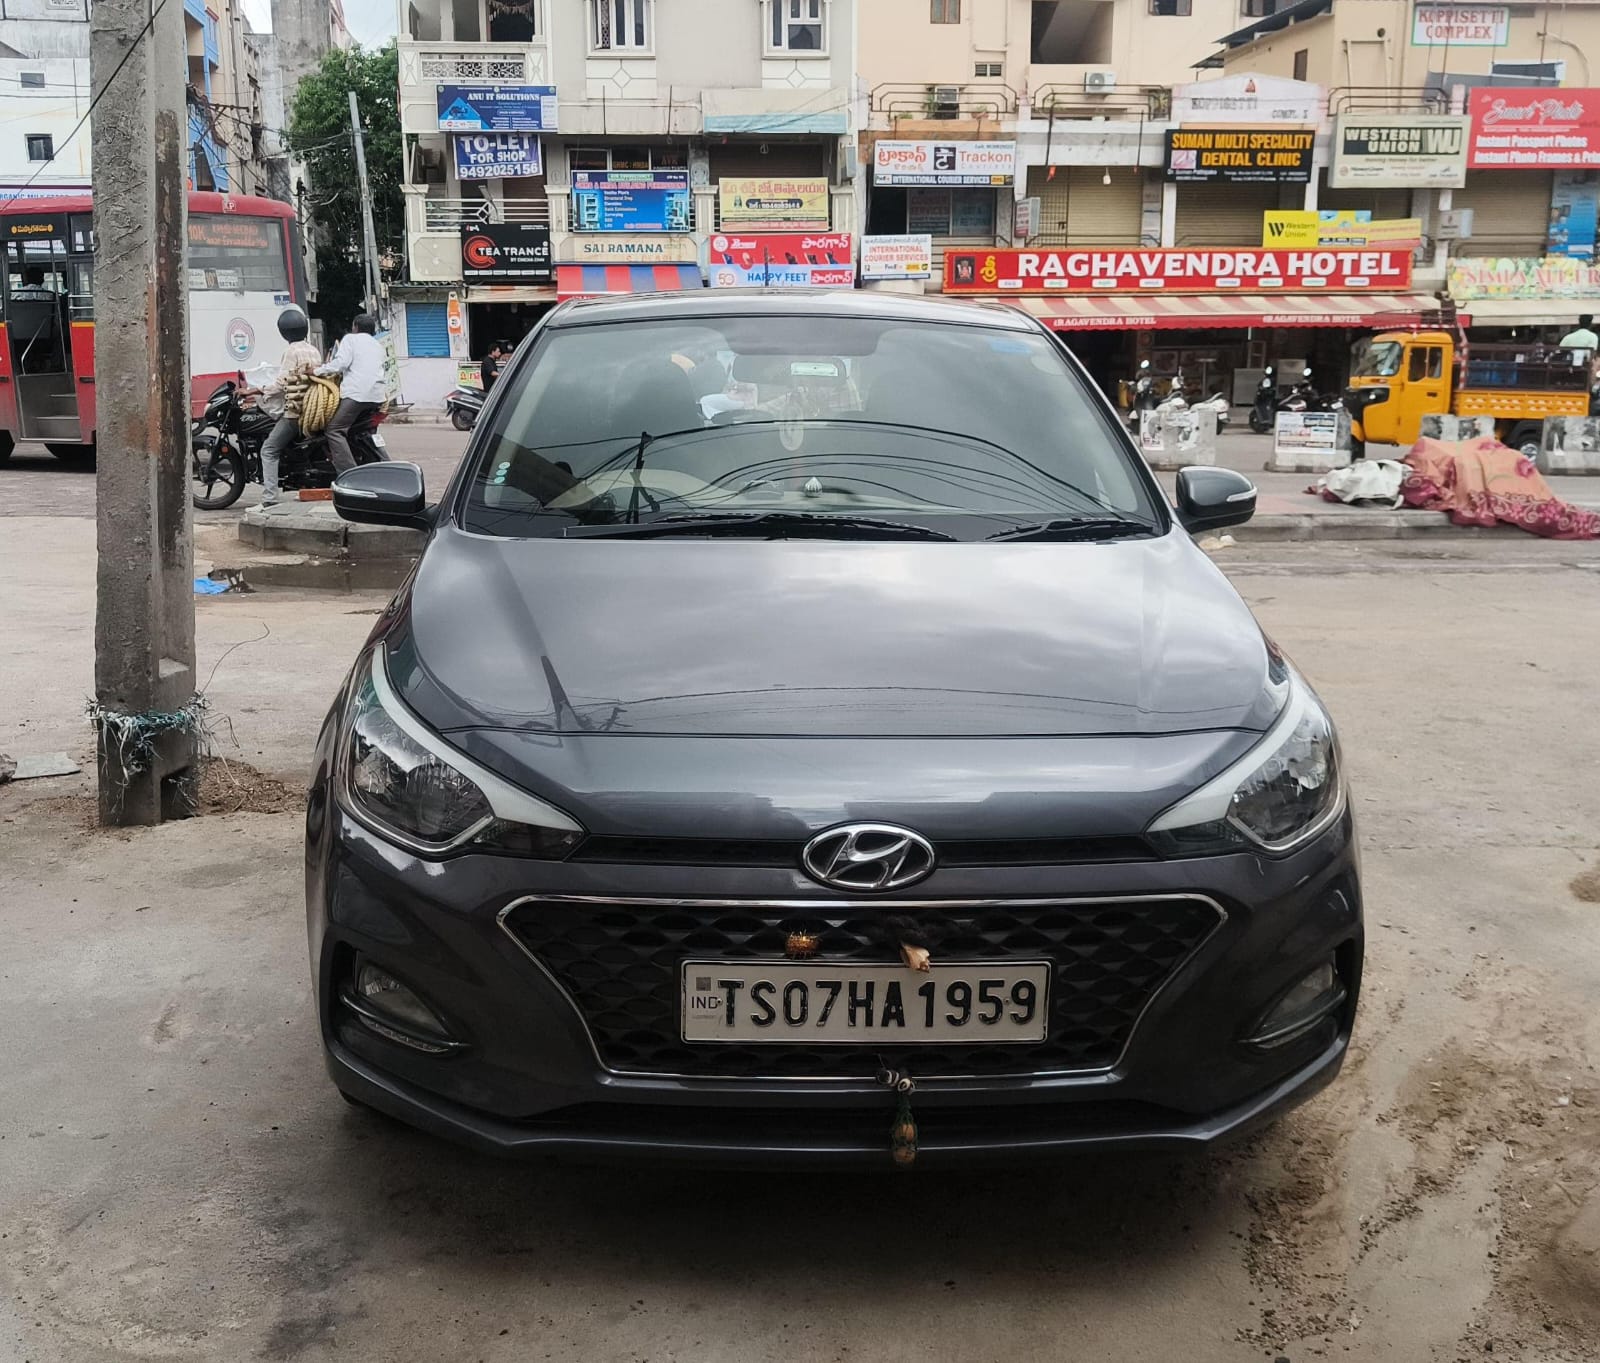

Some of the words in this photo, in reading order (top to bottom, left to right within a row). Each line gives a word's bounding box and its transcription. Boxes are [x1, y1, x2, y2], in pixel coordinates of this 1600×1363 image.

[1425, 25, 1492, 39] COMPLEX
[467, 93, 484, 101] ANU
[496, 93, 540, 101] SOLUTIONS
[1345, 128, 1421, 140] WESTERN
[460, 134, 530, 153] TO-LET
[1171, 133, 1213, 149] SUMAN
[1214, 133, 1249, 149] MULTI
[1250, 133, 1313, 149] SPECIALITY
[1367, 141, 1420, 153] UNION
[470, 153, 494, 164] FOR
[497, 150, 527, 162] SHOP
[960, 151, 1012, 163] Trackon
[1201, 151, 1253, 166] DENTAL
[1256, 151, 1301, 167] CLINIC
[460, 163, 538, 178] 9492025156
[893, 175, 937, 184] INTERNATIONAL
[478, 247, 501, 256] TEA
[503, 247, 549, 256] TRANCE
[583, 243, 605, 253] SAI
[608, 243, 664, 253] RAMANA
[869, 245, 924, 253] INTERNATIONAL
[864, 254, 895, 262] COURIER
[896, 254, 929, 262] SERVICES
[1017, 252, 1281, 277] RAGHAVENDRA
[1287, 252, 1400, 276] HOTEL
[747, 272, 781, 282] HAPPY
[785, 272, 807, 281] FEET
[1126, 317, 1157, 325] HOTEL
[1332, 315, 1363, 323] HOTEL
[691, 996, 719, 1009] IND
[717, 979, 1037, 1027] TS07HA1959
